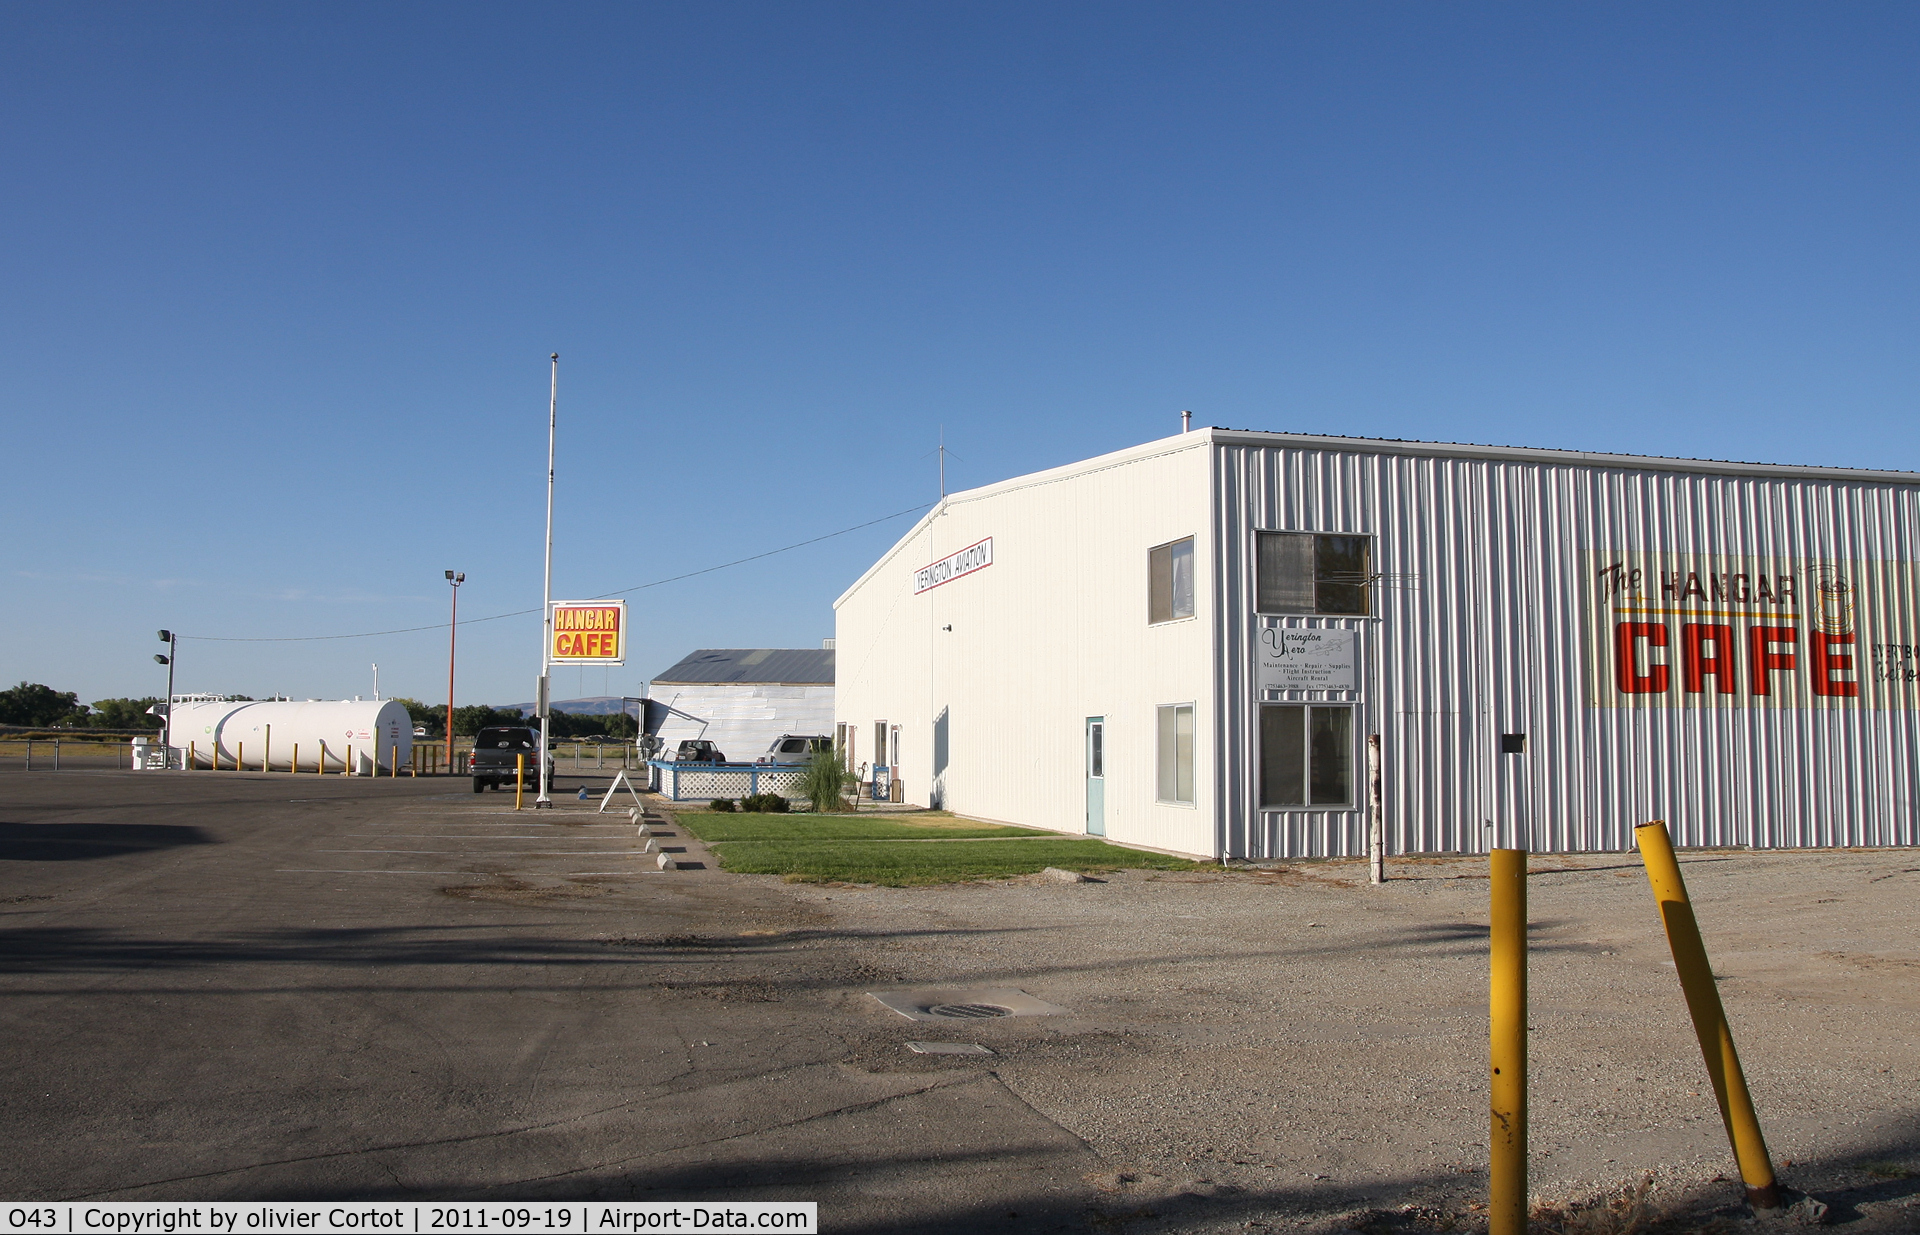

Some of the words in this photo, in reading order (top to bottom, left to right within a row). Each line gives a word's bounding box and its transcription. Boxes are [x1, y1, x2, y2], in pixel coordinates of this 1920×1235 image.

[917, 559, 952, 590] YERINGTON
[955, 543, 987, 575] AVIATION
[1599, 561, 1642, 604] The
[1661, 571, 1796, 604] HANGAR
[556, 610, 615, 630] HANGAR
[556, 633, 613, 656] CAFE
[1262, 628, 1321, 658] Yerington
[1616, 621, 1859, 697] CAFE
